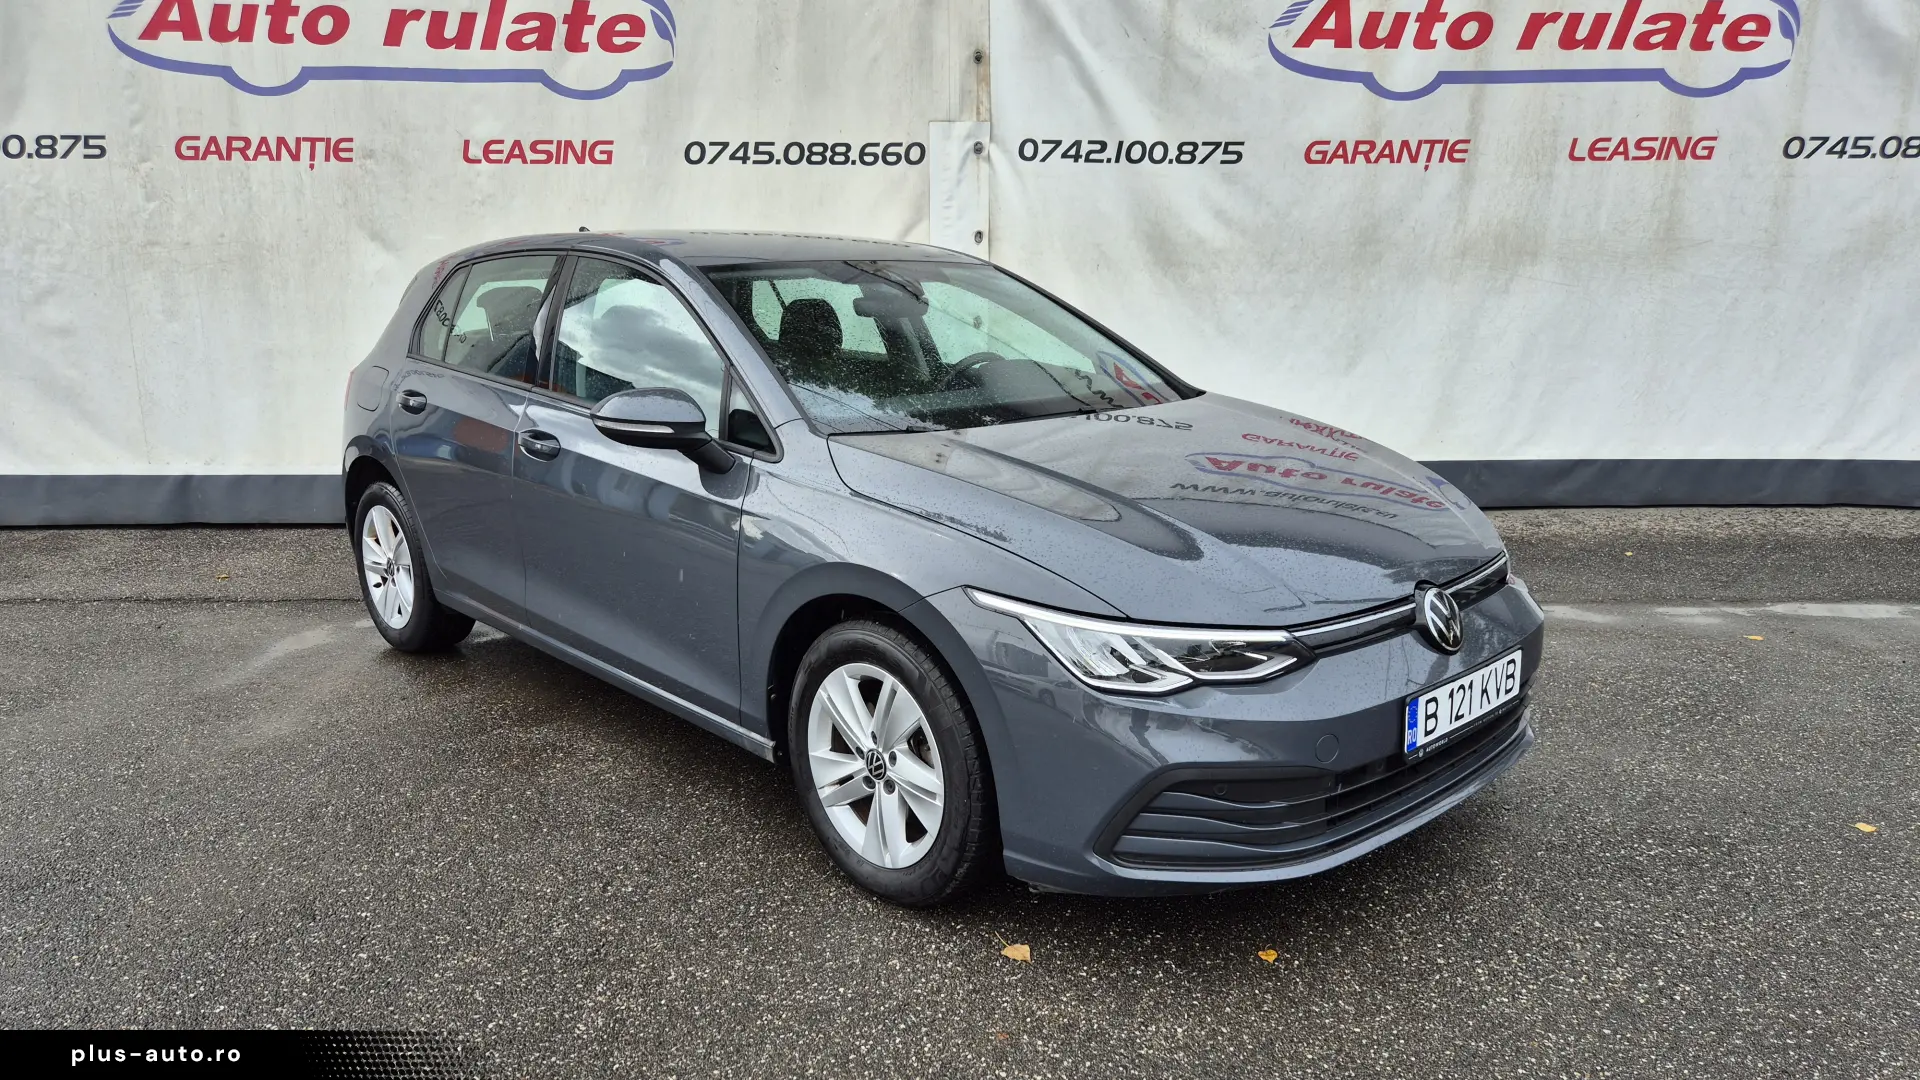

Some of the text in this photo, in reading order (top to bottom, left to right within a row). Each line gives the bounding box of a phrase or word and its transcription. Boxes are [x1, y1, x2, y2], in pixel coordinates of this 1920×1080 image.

[138, 0, 646, 53] Auto rulate
[1292, 0, 1771, 52] Auto rulate
[2, 134, 107, 159] 0.875
[174, 136, 354, 170] GARANȚIE
[462, 139, 614, 165] LEASING
[684, 141, 926, 166] 0745.088.660
[1018, 138, 1245, 164] 0742.100.875
[1304, 139, 1471, 171] GARANȚIE
[1568, 137, 1718, 162] LEASING
[1423, 696, 1439, 738] B
[1448, 679, 1474, 725] 121
[1479, 658, 1517, 710] KVB
[1407, 727, 1417, 746] RO
